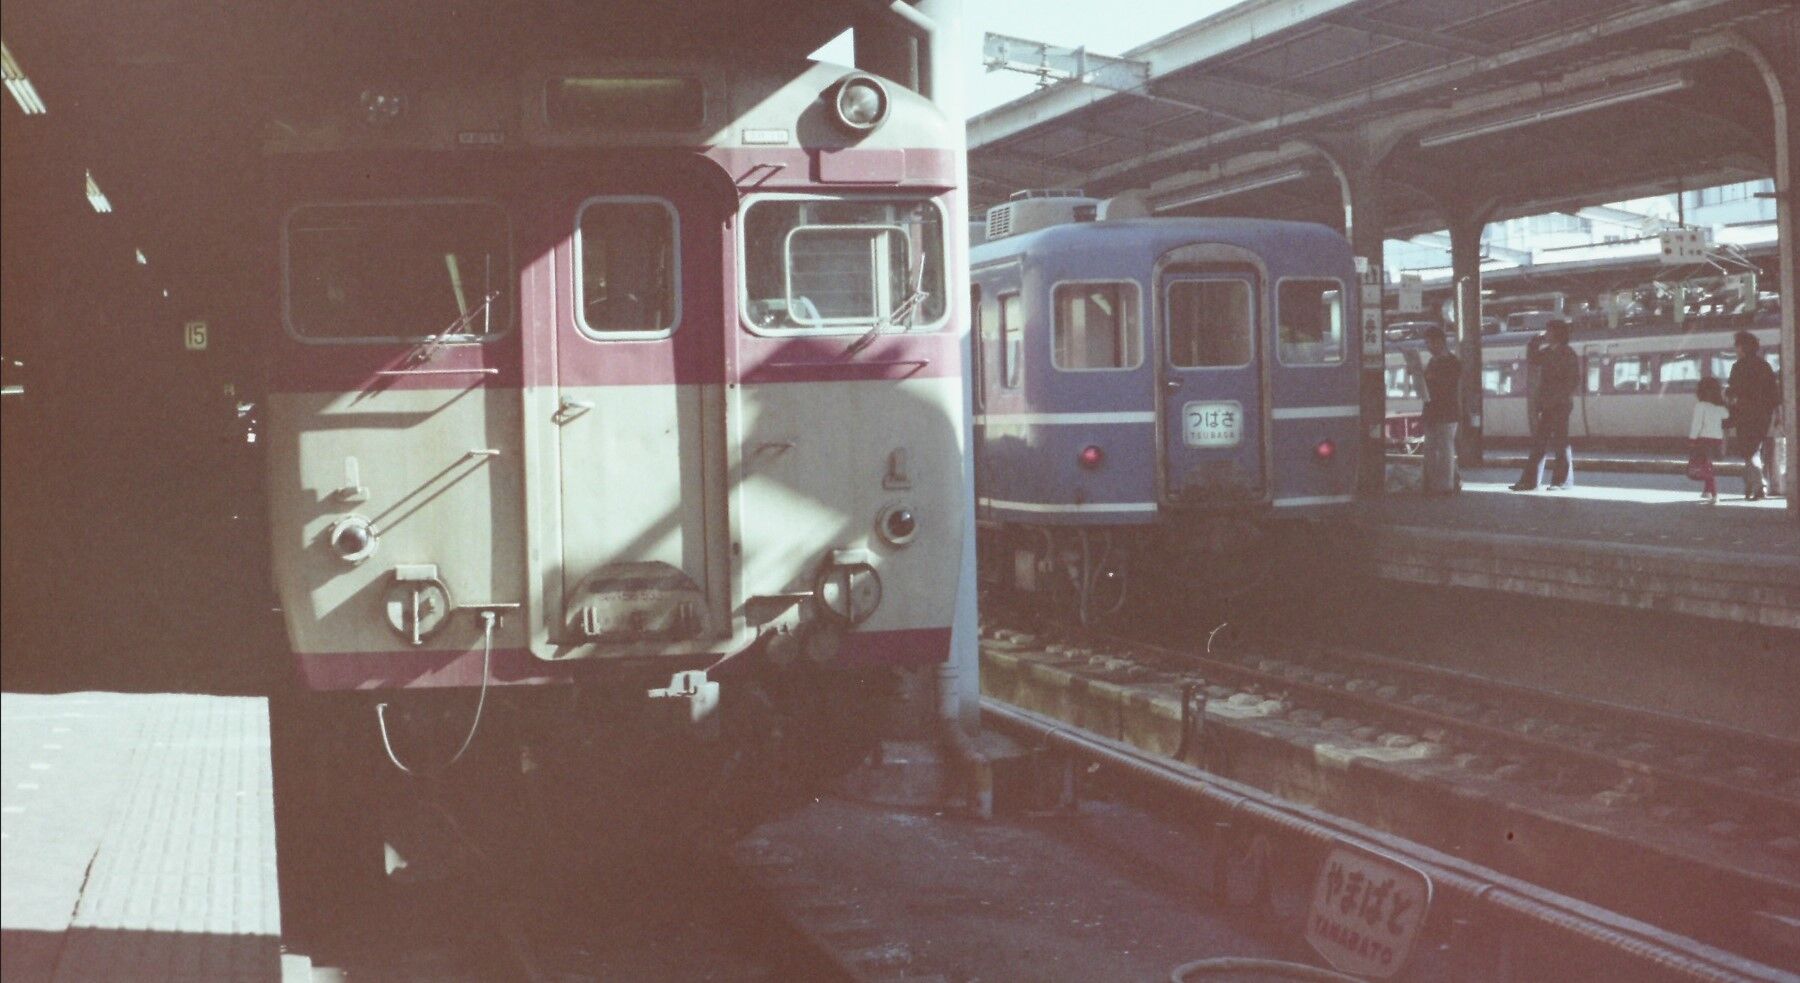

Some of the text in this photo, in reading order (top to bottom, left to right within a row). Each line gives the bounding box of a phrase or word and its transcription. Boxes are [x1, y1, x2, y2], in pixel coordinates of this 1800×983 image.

[188, 324, 205, 345] 15
[1188, 410, 1234, 428] つばさ
[1190, 431, 1235, 440] TSUBASA
[1326, 862, 1413, 936] やまばと
[1316, 914, 1393, 965] YAMABATO
